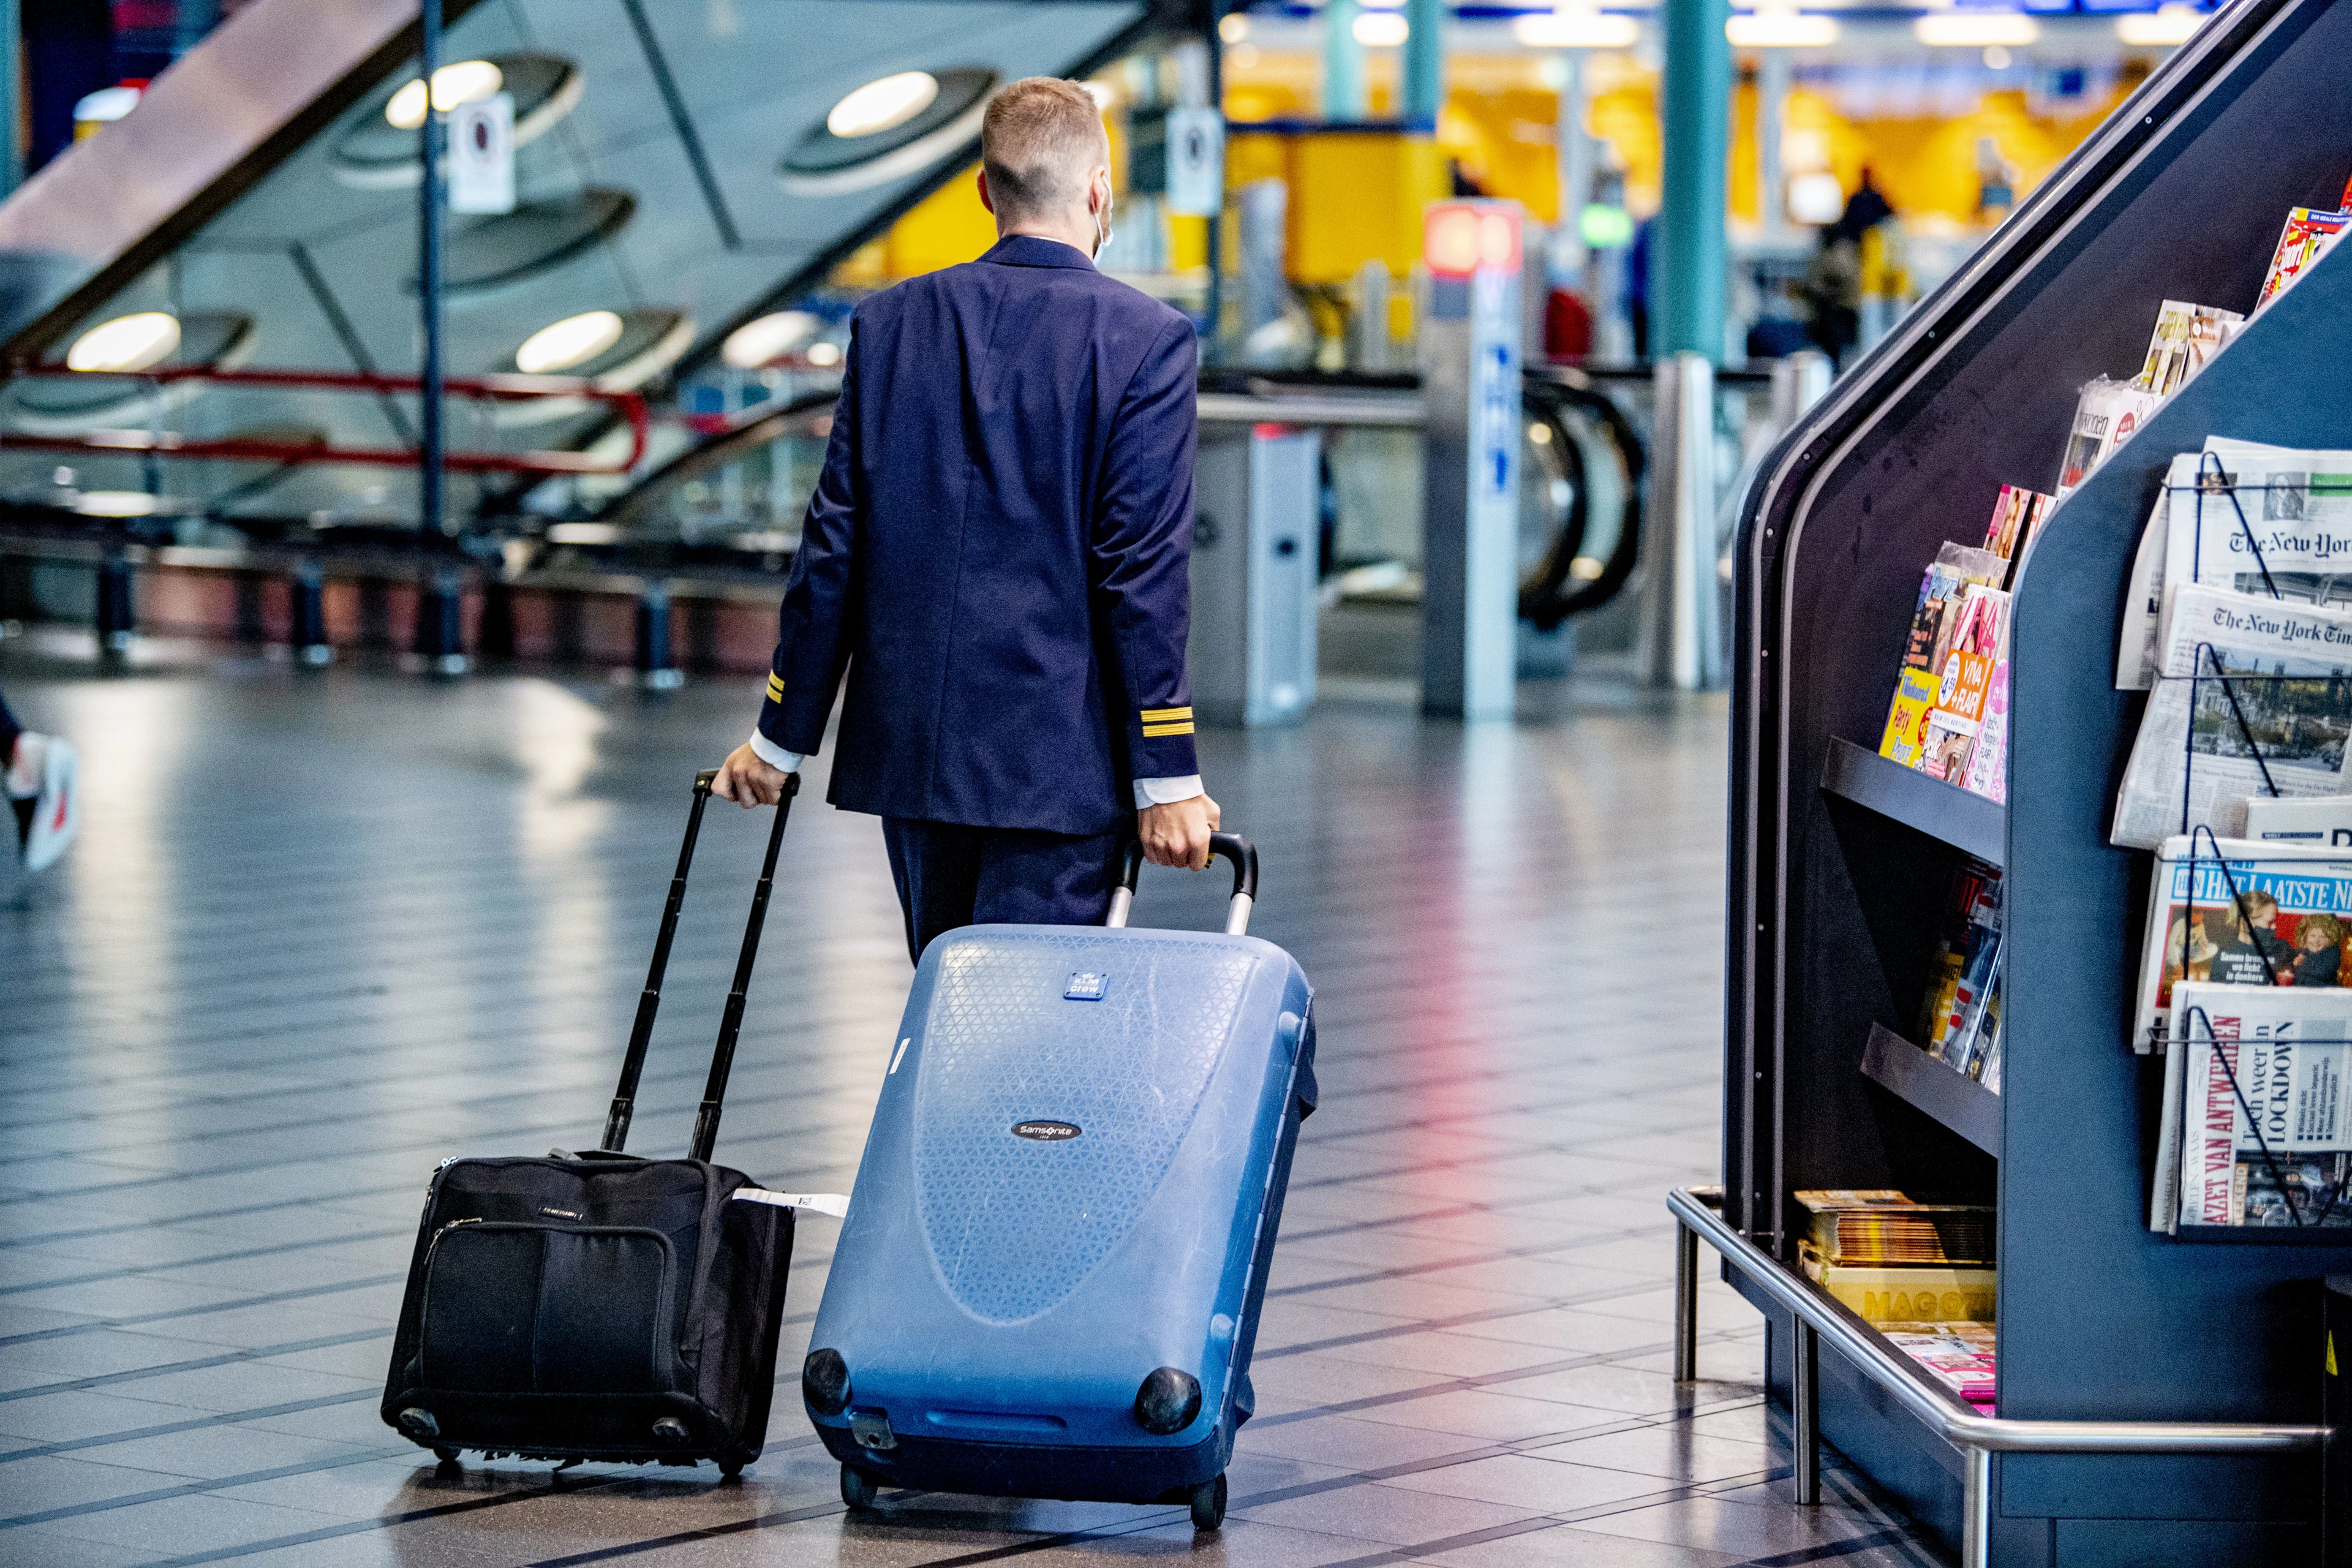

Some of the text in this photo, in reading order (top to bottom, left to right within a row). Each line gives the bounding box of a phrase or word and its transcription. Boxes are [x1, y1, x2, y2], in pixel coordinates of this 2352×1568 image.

[2268, 532, 2310, 552] New
[2213, 607, 2243, 632] The
[2244, 613, 2280, 636] New
[2282, 619, 2320, 641] York
[1963, 659, 1982, 687] VIVA
[2178, 875, 2201, 891] HN
[2251, 1047, 2267, 1094] weer
[2266, 1020, 2294, 1144] LOCKDOWN
[1020, 1126, 1072, 1135] Samsonite
[2204, 1138, 2232, 1174] VAN
